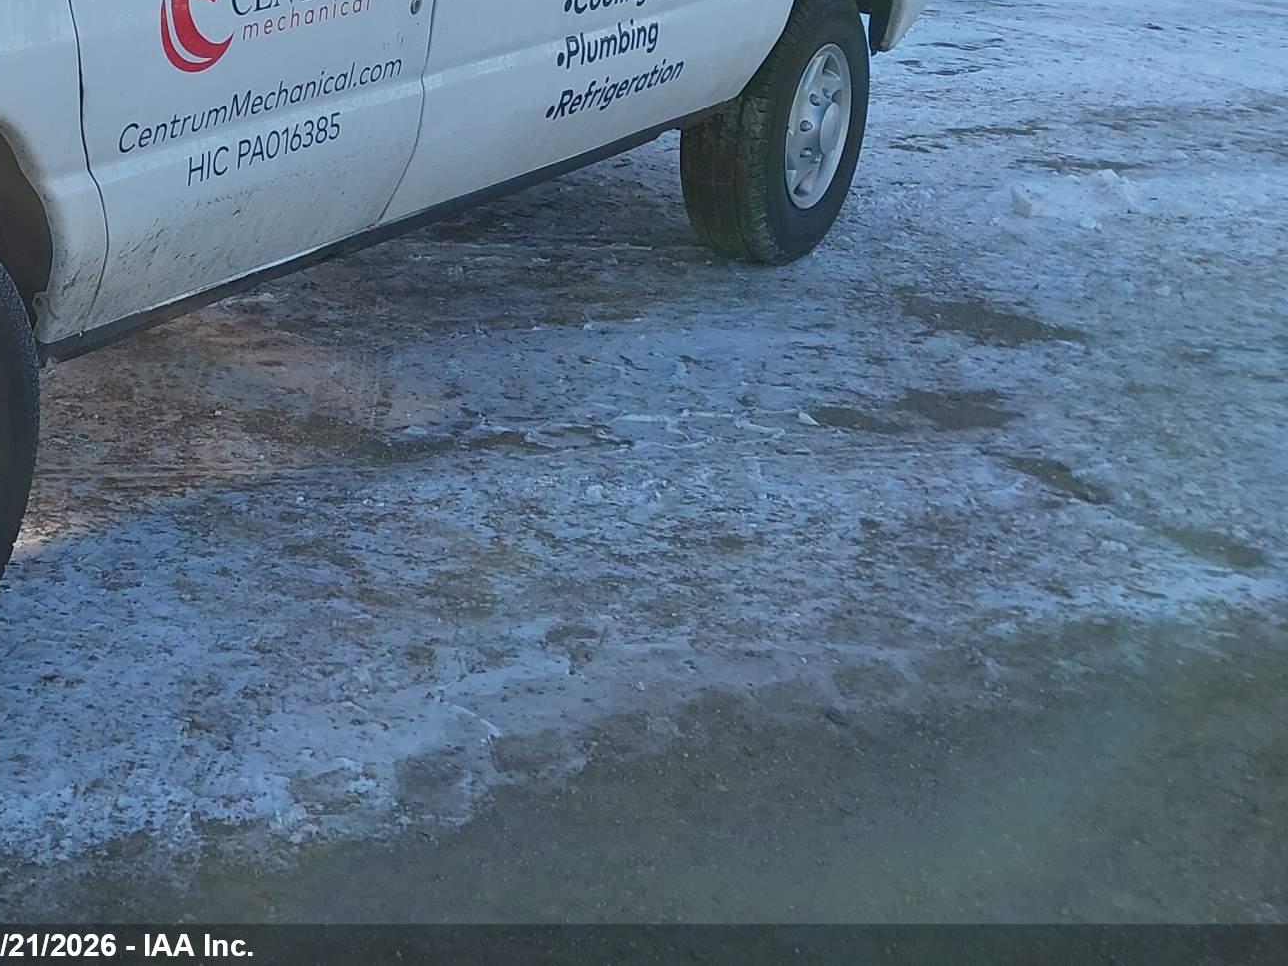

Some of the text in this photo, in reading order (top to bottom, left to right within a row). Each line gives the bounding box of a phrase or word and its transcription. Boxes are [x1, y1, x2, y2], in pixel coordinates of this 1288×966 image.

[564, 19, 659, 69] Plumbing
[118, 57, 403, 154] CentrumMechanical.com
[553, 59, 684, 120] Refrigeration
[187, 112, 341, 187] HIC PA016385
